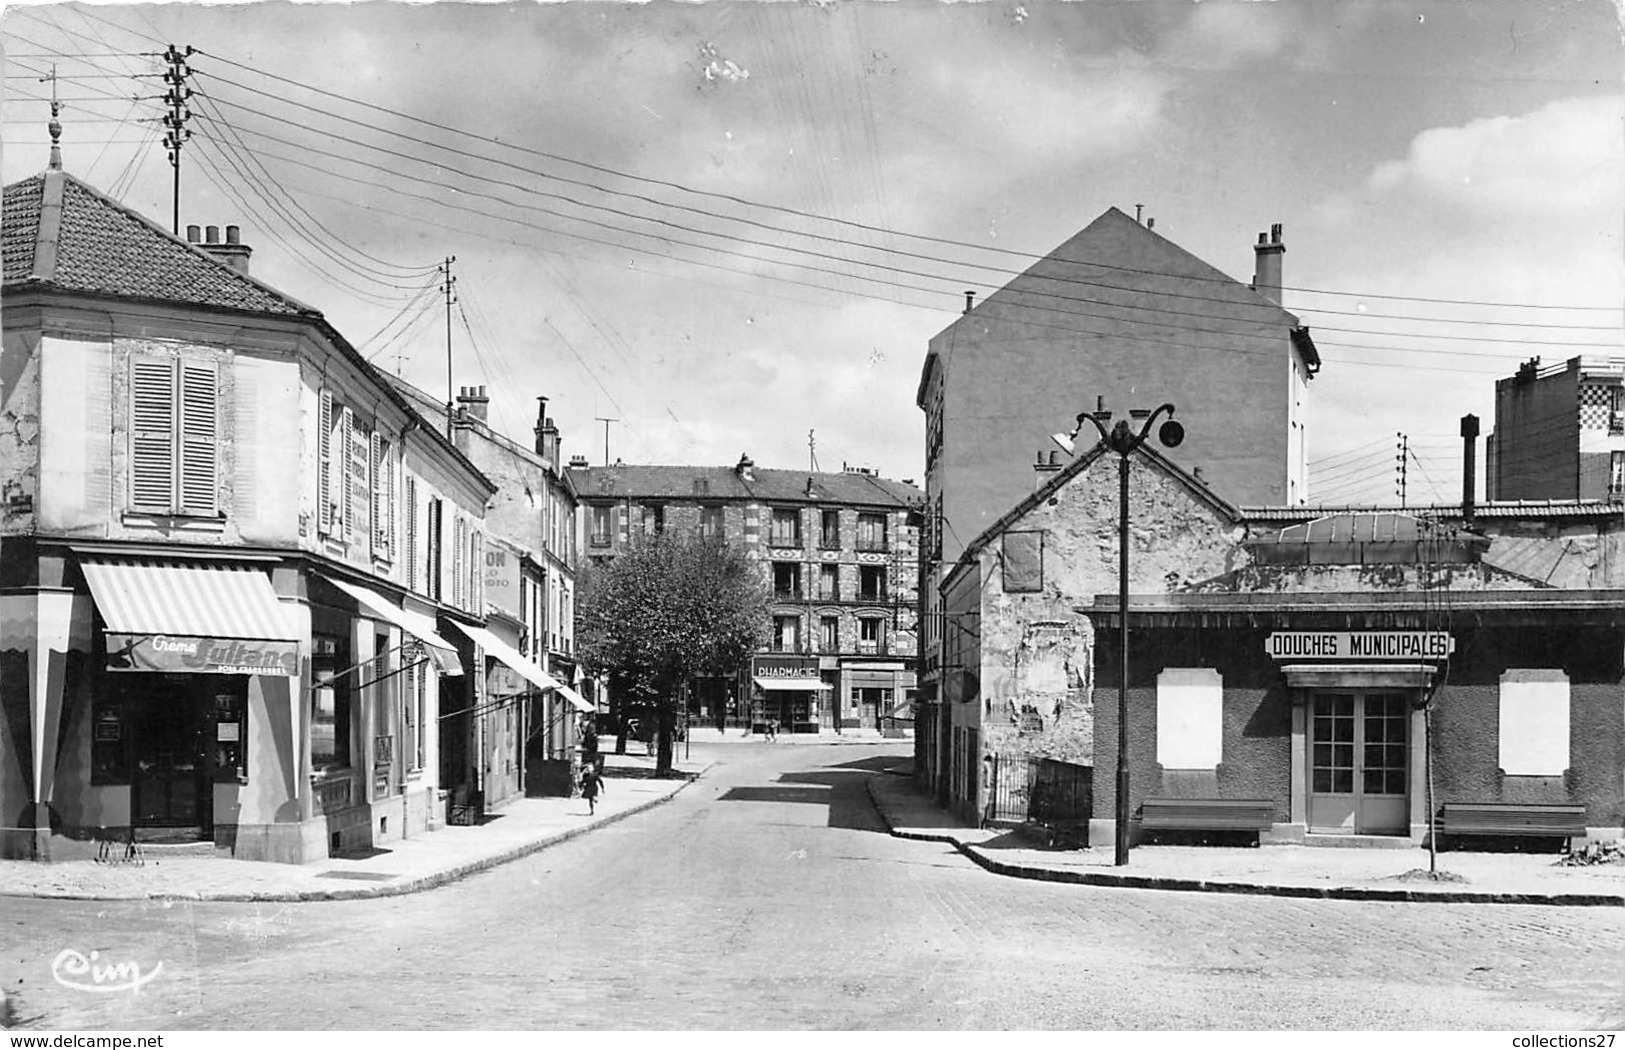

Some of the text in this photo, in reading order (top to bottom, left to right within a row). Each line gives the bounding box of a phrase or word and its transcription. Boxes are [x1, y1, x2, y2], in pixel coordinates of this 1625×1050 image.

[1273, 634, 1447, 656] DOUCHES MUNICIPALES
[757, 666, 816, 678] PHARMACIE
